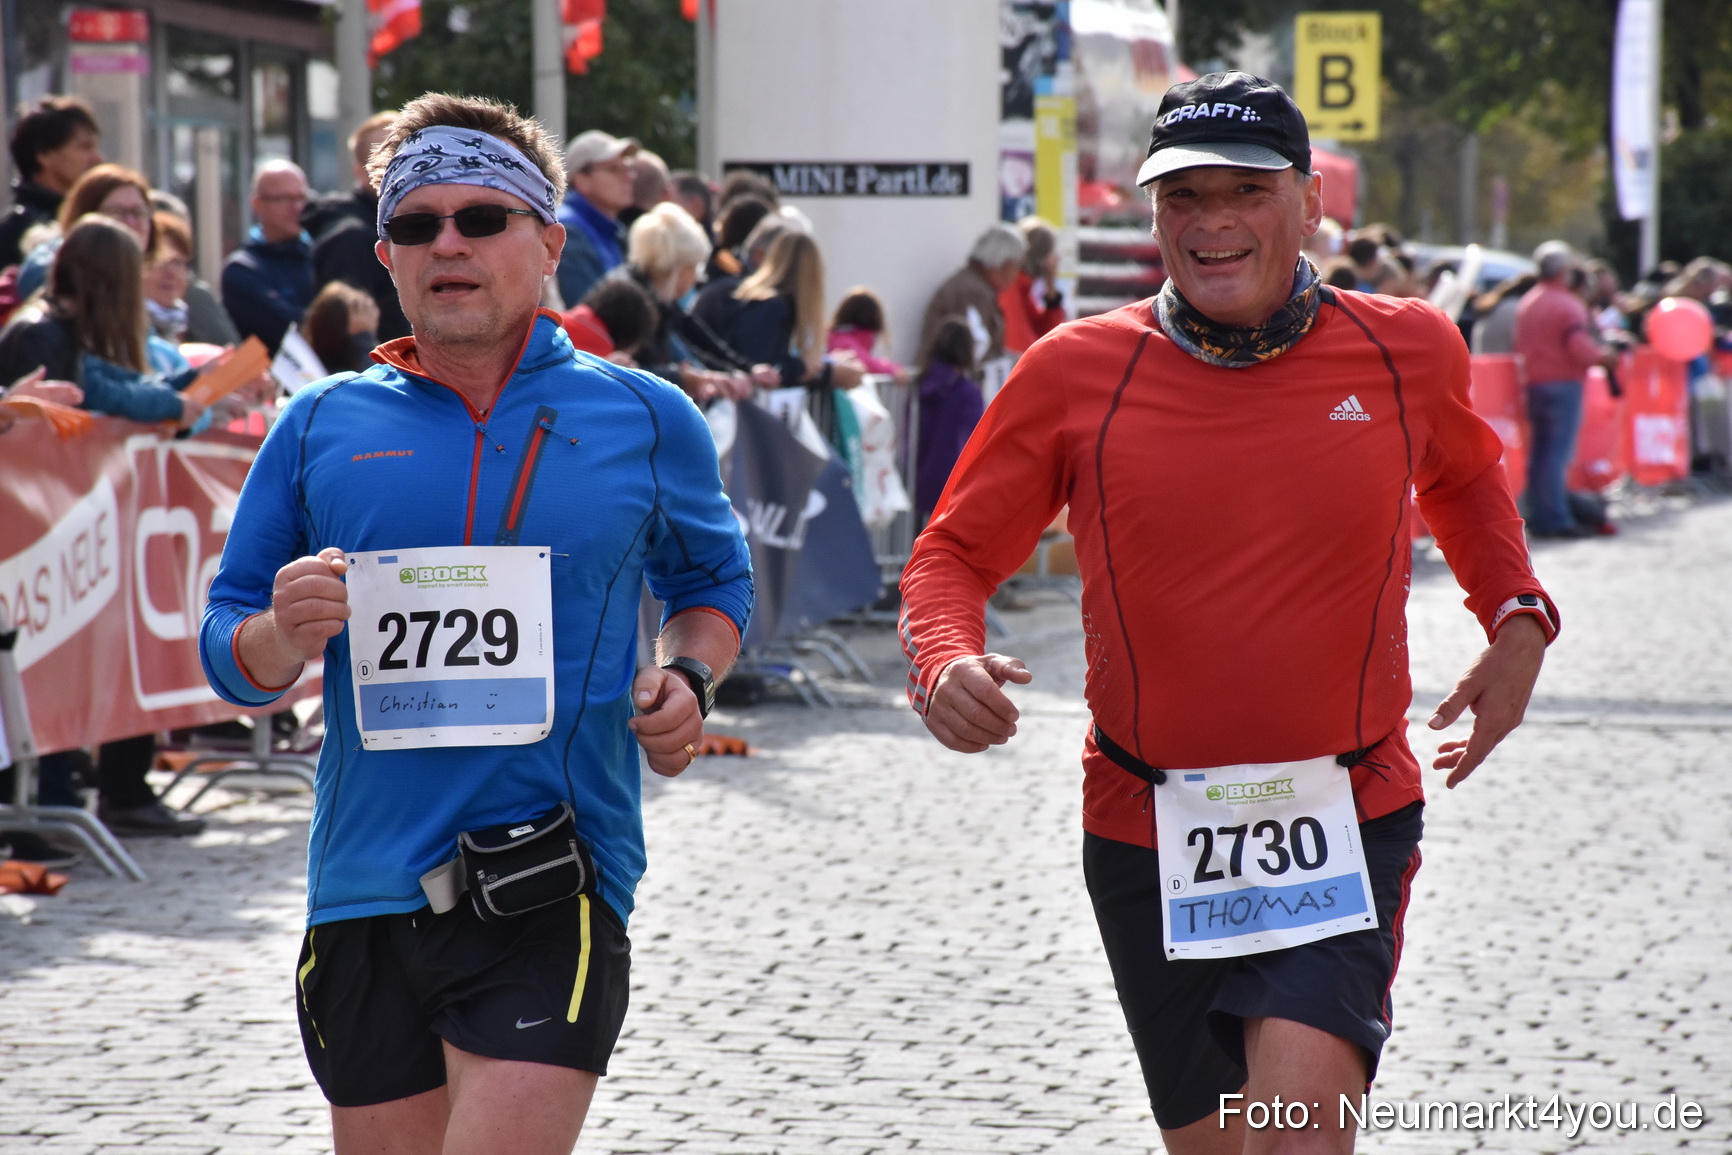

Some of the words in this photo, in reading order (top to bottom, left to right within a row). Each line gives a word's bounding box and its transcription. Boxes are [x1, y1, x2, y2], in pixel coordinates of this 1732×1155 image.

[1306, 22, 1368, 42] Block
[1319, 54, 1356, 110] B
[1165, 102, 1242, 126] CRAFT
[765, 163, 964, 194] MINI-Partl.de
[1329, 410, 1371, 421] adidas
[352, 450, 414, 462] MAMMUT
[0, 566, 50, 640] AS
[60, 509, 110, 616] NEUE
[417, 565, 488, 583] BOCK
[378, 608, 519, 671] 2729
[361, 665, 368, 676] D
[379, 691, 458, 713] Christian
[1226, 778, 1295, 800] BOCK
[1227, 798, 1248, 806] inspired
[1272, 794, 1296, 802] concepts
[1187, 816, 1329, 884] 2730
[1173, 879, 1181, 890] D
[1179, 886, 1338, 934] THOMAS
